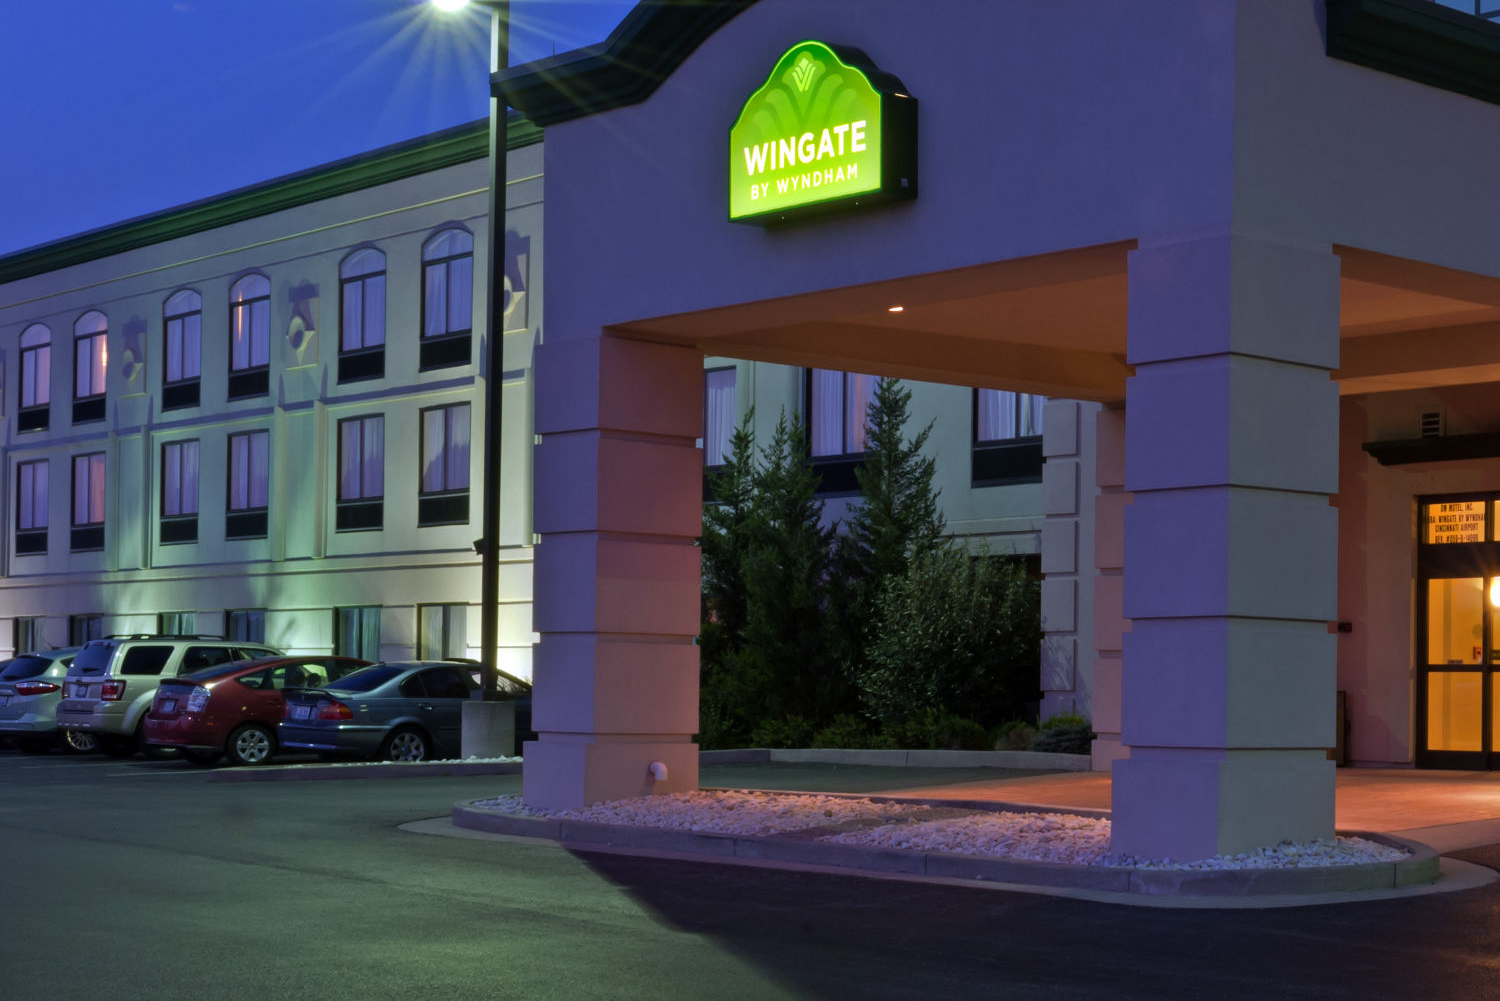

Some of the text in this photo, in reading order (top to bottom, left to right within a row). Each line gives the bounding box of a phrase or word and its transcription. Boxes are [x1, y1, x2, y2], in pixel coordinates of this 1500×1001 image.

[744, 120, 867, 176] WINGATE
[751, 163, 858, 200] BY WYNDHAM
[1435, 523, 1478, 532] CINCINNATI AIRPORT
[1439, 515, 1456, 523] WINGATE
[1458, 514, 1464, 523] BY
